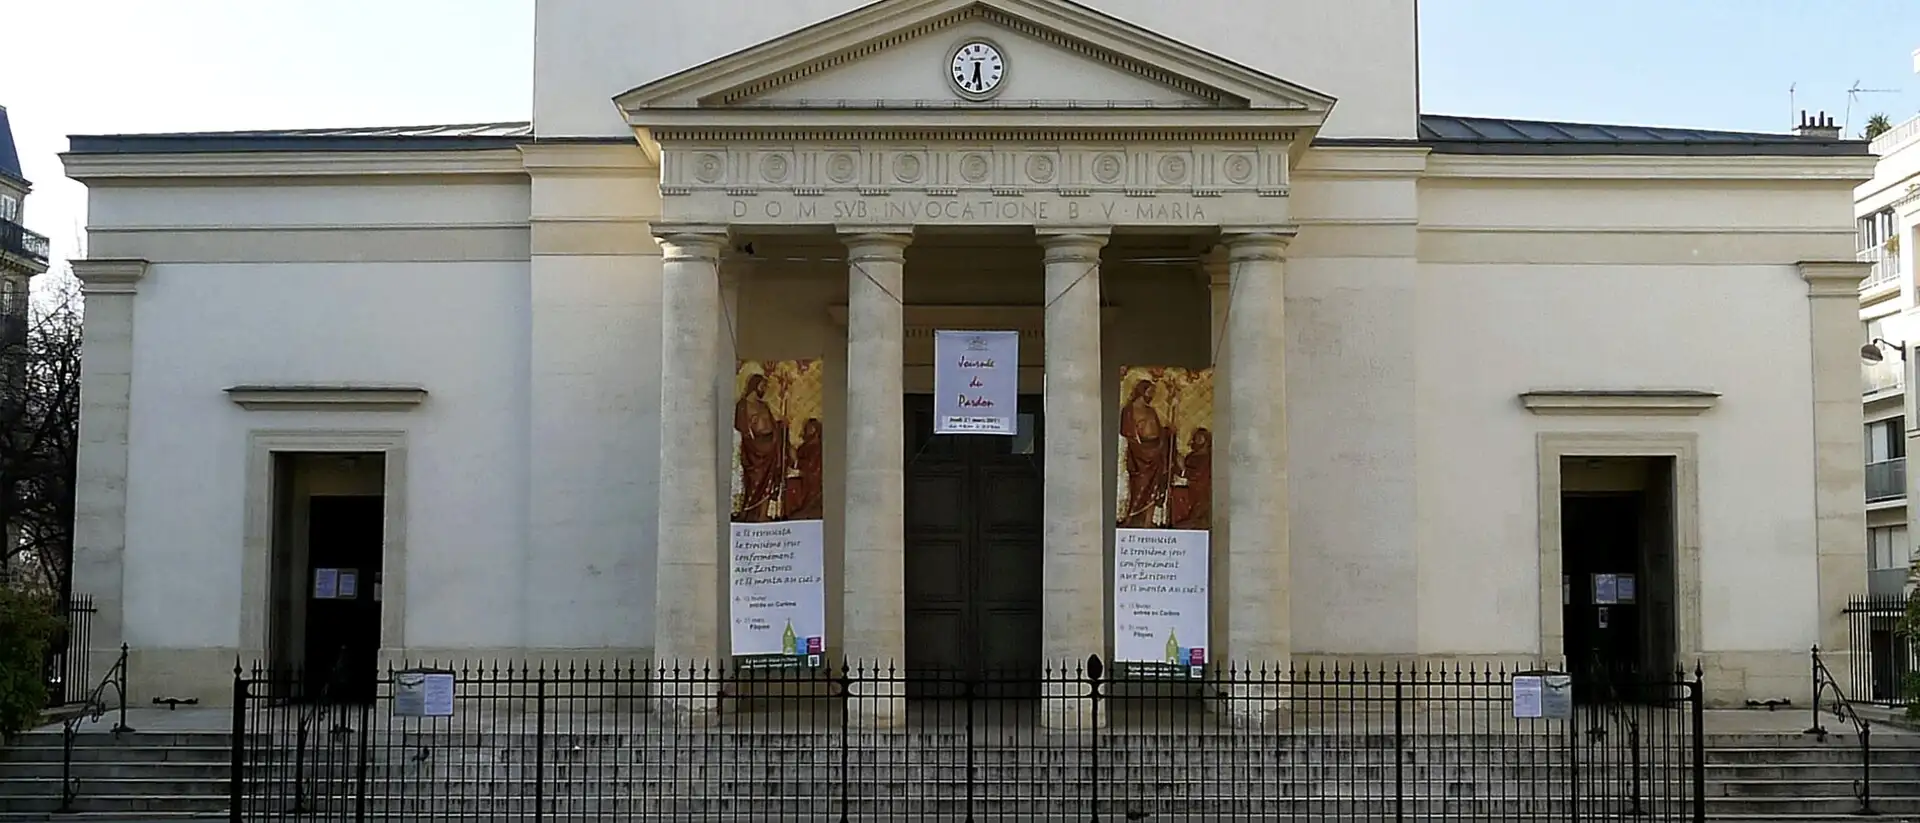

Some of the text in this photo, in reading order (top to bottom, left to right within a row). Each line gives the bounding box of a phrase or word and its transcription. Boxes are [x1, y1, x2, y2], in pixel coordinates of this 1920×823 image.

[798, 201, 816, 218] M
[883, 201, 1048, 219] INVOCATIONE
[1136, 201, 1205, 220] MARIA
[958, 394, 994, 408] Pardon
